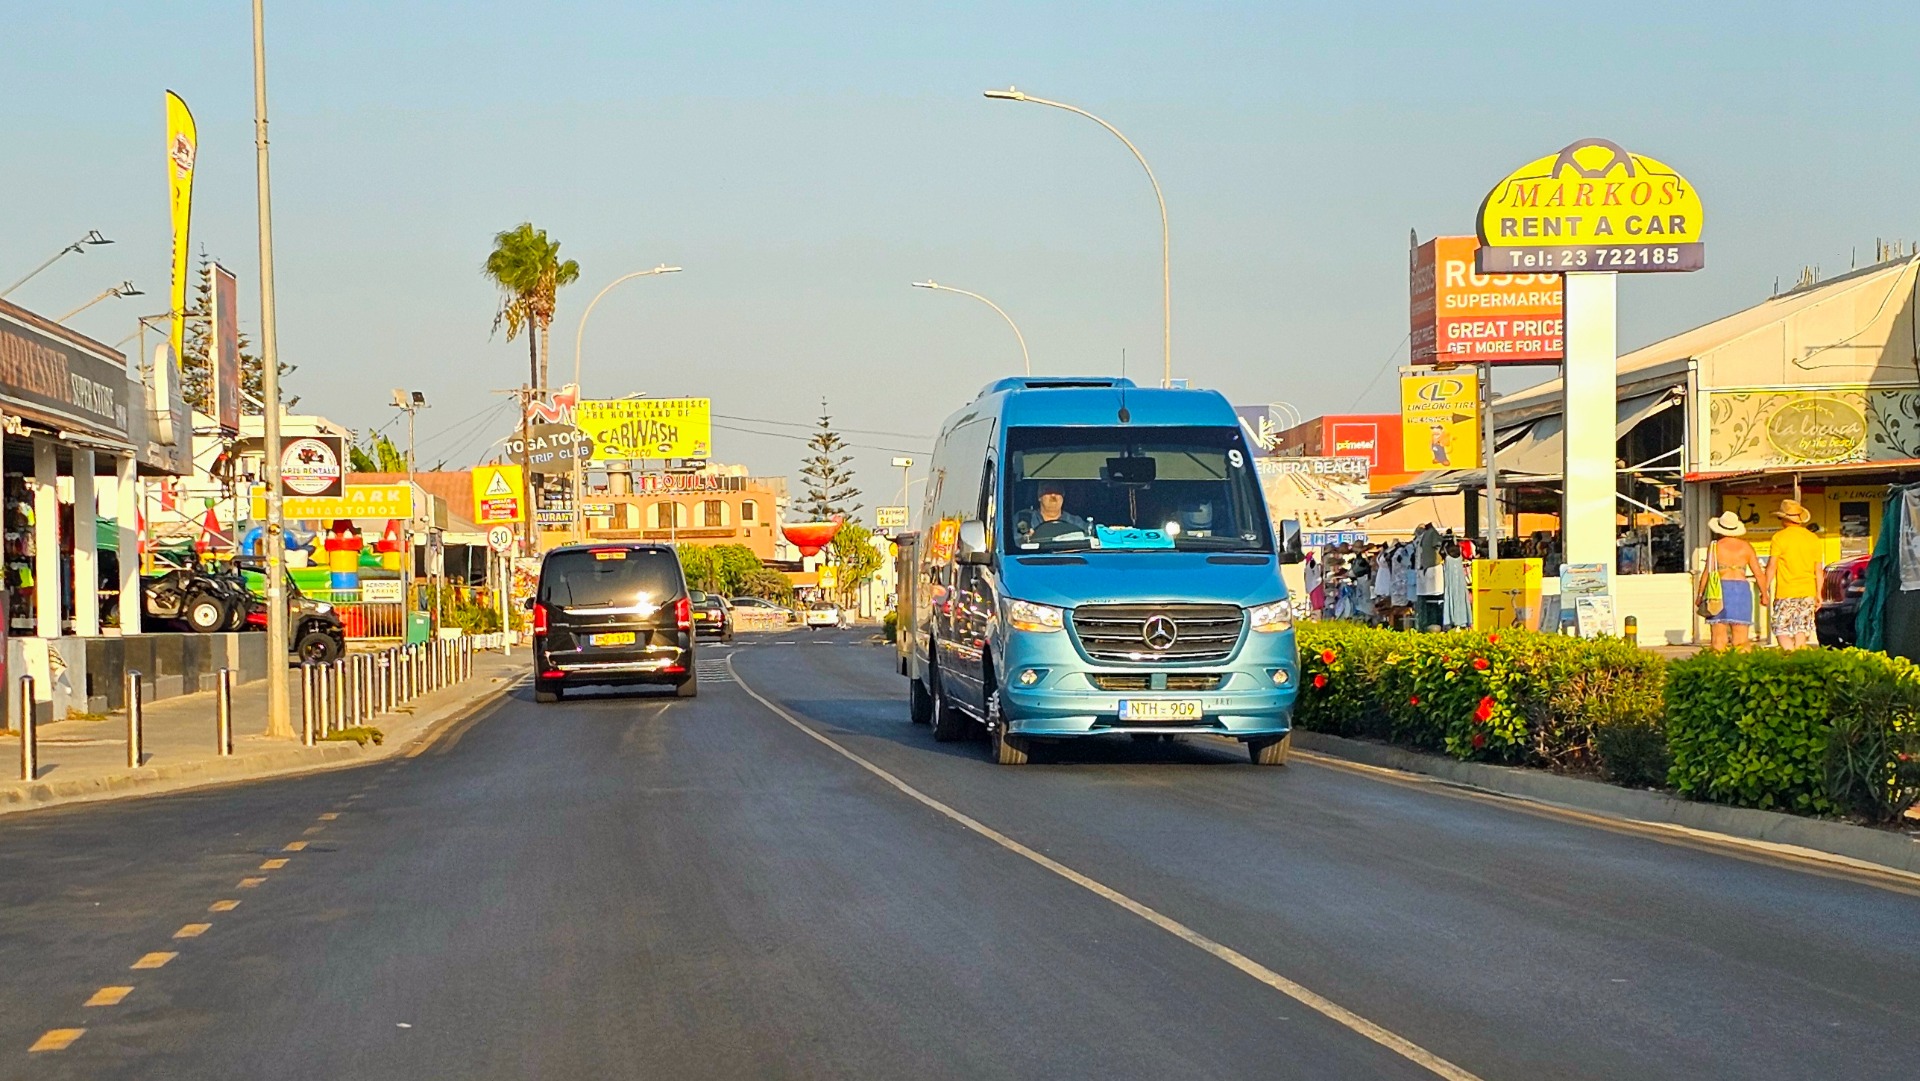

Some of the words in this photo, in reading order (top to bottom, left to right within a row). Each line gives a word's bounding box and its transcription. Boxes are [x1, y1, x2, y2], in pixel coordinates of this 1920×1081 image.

[1511, 181, 1677, 208] MARKOS
[1500, 216, 1583, 237] RENT
[1594, 215, 1614, 236] A
[1625, 214, 1687, 235] CAR
[1509, 250, 1553, 267] Tel:
[1561, 249, 1588, 266] 23
[1595, 247, 1679, 265] 722185
[1445, 291, 1563, 308] SUPERMARKE
[1447, 321, 1509, 340] GREAT
[1513, 320, 1563, 337] PRICE
[1447, 341, 1473, 355] GET
[1476, 341, 1514, 354] MORE
[1516, 340, 1542, 353] FOR
[1544, 339, 1563, 352] LE
[577, 402, 620, 411] ELCOME
[597, 419, 678, 449] CARWASH
[503, 436, 548, 455] TOGA
[521, 452, 554, 465] TRIP
[1228, 449, 1243, 468] 9
[1256, 462, 1310, 475] ERNERA
[1314, 460, 1361, 475] BEACH
[639, 474, 718, 491] TEQUILA
[491, 531, 508, 545] 30
[1131, 702, 1158, 716] NTH
[1171, 702, 1195, 716] 909
